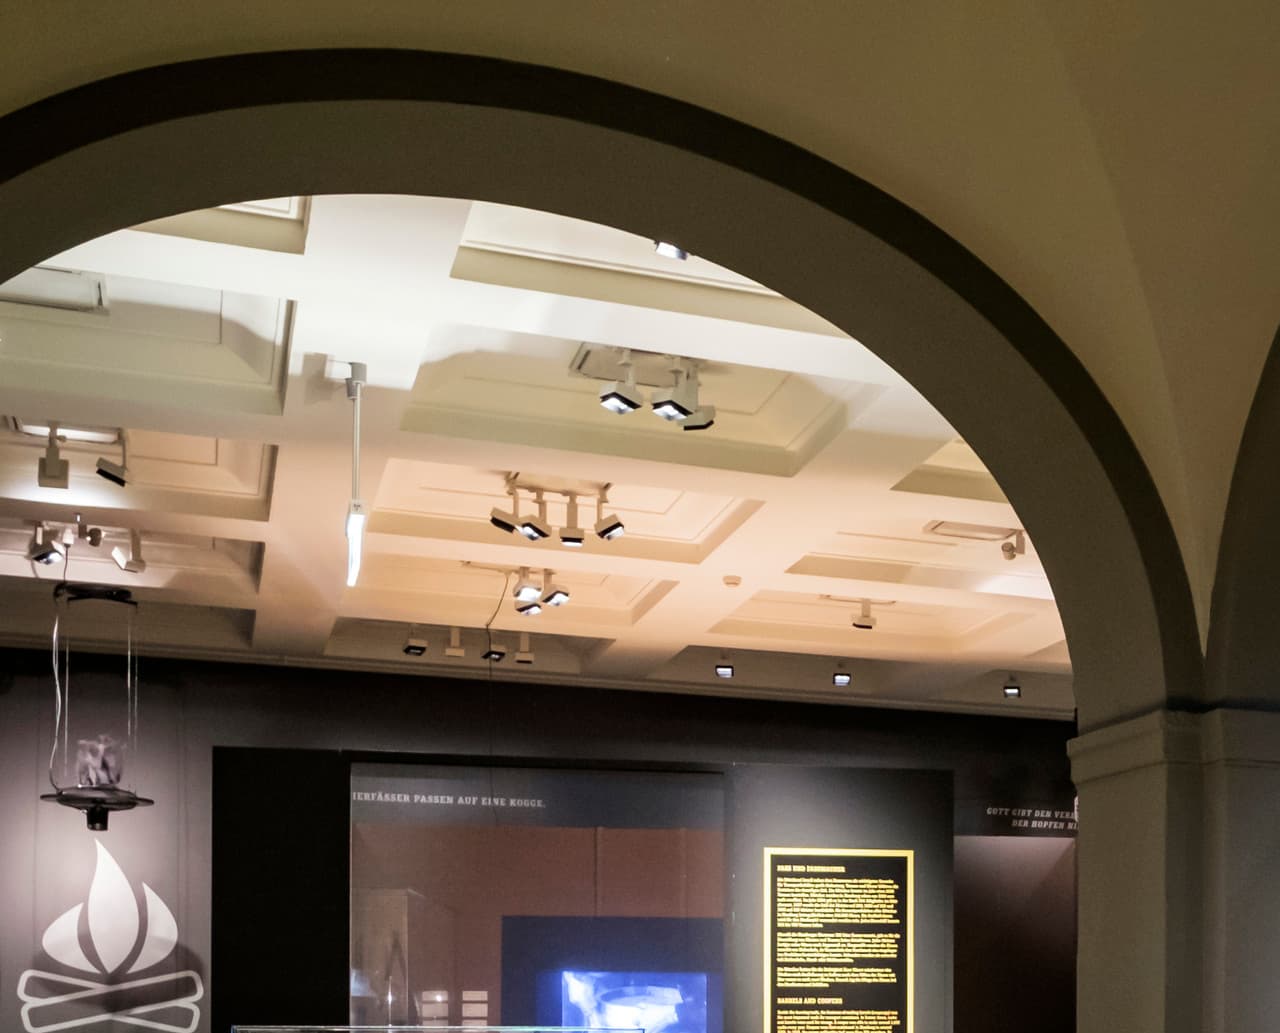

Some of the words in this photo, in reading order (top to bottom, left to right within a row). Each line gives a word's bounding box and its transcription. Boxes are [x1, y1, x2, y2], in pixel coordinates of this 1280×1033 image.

[352, 791, 410, 803] IERFÄSSER
[414, 793, 453, 804] PASSEN
[457, 796, 478, 805] AUF
[481, 797, 507, 807] EINE
[1034, 809, 1052, 818] DEN
